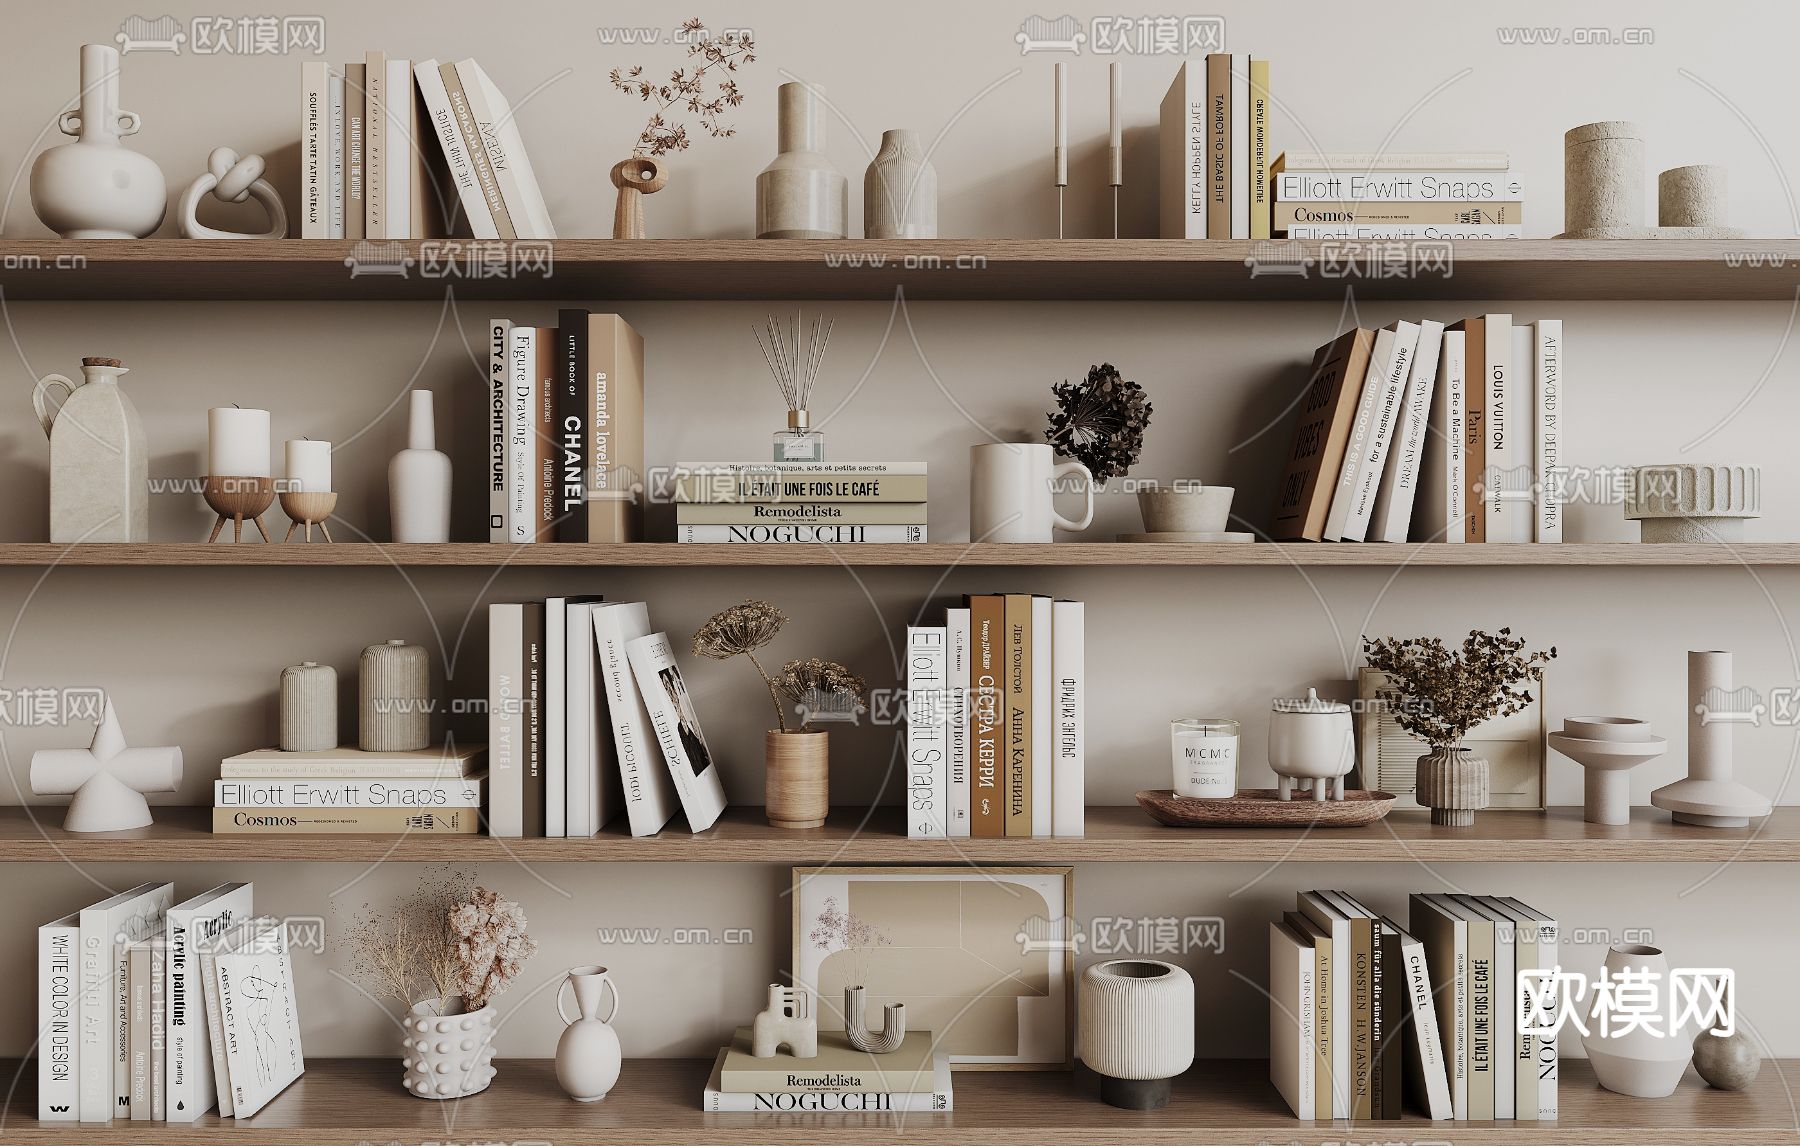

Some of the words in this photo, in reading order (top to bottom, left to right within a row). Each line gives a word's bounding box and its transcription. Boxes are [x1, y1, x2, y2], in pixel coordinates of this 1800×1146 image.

[309, 92, 318, 131] SOUFFLÉS
[309, 134, 318, 158] TARTE
[309, 160, 318, 184] TATIN
[309, 187, 318, 224] GÂTEAUX
[1284, 177, 1341, 199] Elliott
[1351, 177, 1412, 199] Erwitt
[1421, 177, 1493, 202] Snaps
[1294, 206, 1353, 222] Cosmos
[493, 326, 504, 360] CITY
[513, 335, 530, 381] Figure
[493, 363, 504, 374] &
[1453, 378, 1461, 389] To
[1494, 365, 1504, 398] LOUIS
[1545, 336, 1557, 410] AFTERWORD
[513, 386, 530, 445] Drawing
[596, 372, 610, 428] amanda
[1368, 449, 1379, 463] for
[1378, 385, 1396, 439] sustainable
[1389, 346, 1409, 384] lifestyle
[1453, 393, 1461, 406] Be
[493, 379, 504, 491] ARCHITECTURE
[1468, 410, 1482, 444] Paris
[1494, 402, 1504, 450] VUITTON
[1545, 414, 1557, 429] BY
[1453, 418, 1461, 460] Machine
[543, 458, 554, 487] Antoine
[564, 415, 581, 512] CHANEL
[596, 431, 610, 489] lovelace
[1343, 462, 1355, 486] THIS
[785, 483, 806, 496] UNE
[810, 483, 833, 496] FOIS
[836, 483, 848, 496] LE
[852, 480, 879, 496] CAFÉ
[543, 490, 554, 521] Predock
[753, 505, 842, 518] Remodelista
[728, 526, 866, 543] NOGUCHI
[912, 633, 942, 681] Elliott
[979, 675, 994, 734] СЕСТРА
[1061, 678, 1077, 718] ФРИДРИХ
[953, 687, 964, 783] СТИХОТВОРЕНИЯ
[1061, 722, 1077, 758] ЭНГЕЛЬС
[907, 749, 942, 810] Snaps
[979, 738, 994, 788] КЕРРИ
[222, 784, 284, 805] Elliott
[293, 784, 359, 805] Erwitt
[368, 783, 447, 808] Snaps
[234, 812, 297, 826] Cosmos
[203, 909, 233, 940] Acrylic
[52, 935, 69, 972] WHITE
[173, 927, 186, 969] Acrylic
[152, 950, 166, 993] Zaha
[1320, 969, 1329, 993] Home
[1355, 953, 1366, 1010] KONSTEN
[1409, 955, 1427, 1010] CHANEL
[1473, 960, 1488, 981] CAFÉ
[52, 976, 69, 1018] COLOR
[173, 974, 186, 1026] painting
[1320, 995, 1329, 1003] in
[1374, 985, 1382, 998] die
[1473, 983, 1488, 993] LE
[119, 1005, 127, 1019] and
[221, 966, 235, 1028] ABSTRACT
[228, 1031, 238, 1055] ART
[1320, 1005, 1329, 1035] Joshua
[1473, 996, 1488, 1015] FOIS
[52, 1021, 69, 1033] IN
[119, 1021, 127, 1062] Accessories
[152, 1000, 166, 1050] Hadid
[1473, 1018, 1488, 1034] UNE
[52, 1037, 69, 1081] DESIGN
[1320, 1038, 1329, 1056] Tree
[1473, 1037, 1488, 1061] ÉTAIT
[786, 1074, 861, 1087] Remodelista
[753, 1093, 891, 1111] NOGUCHI
